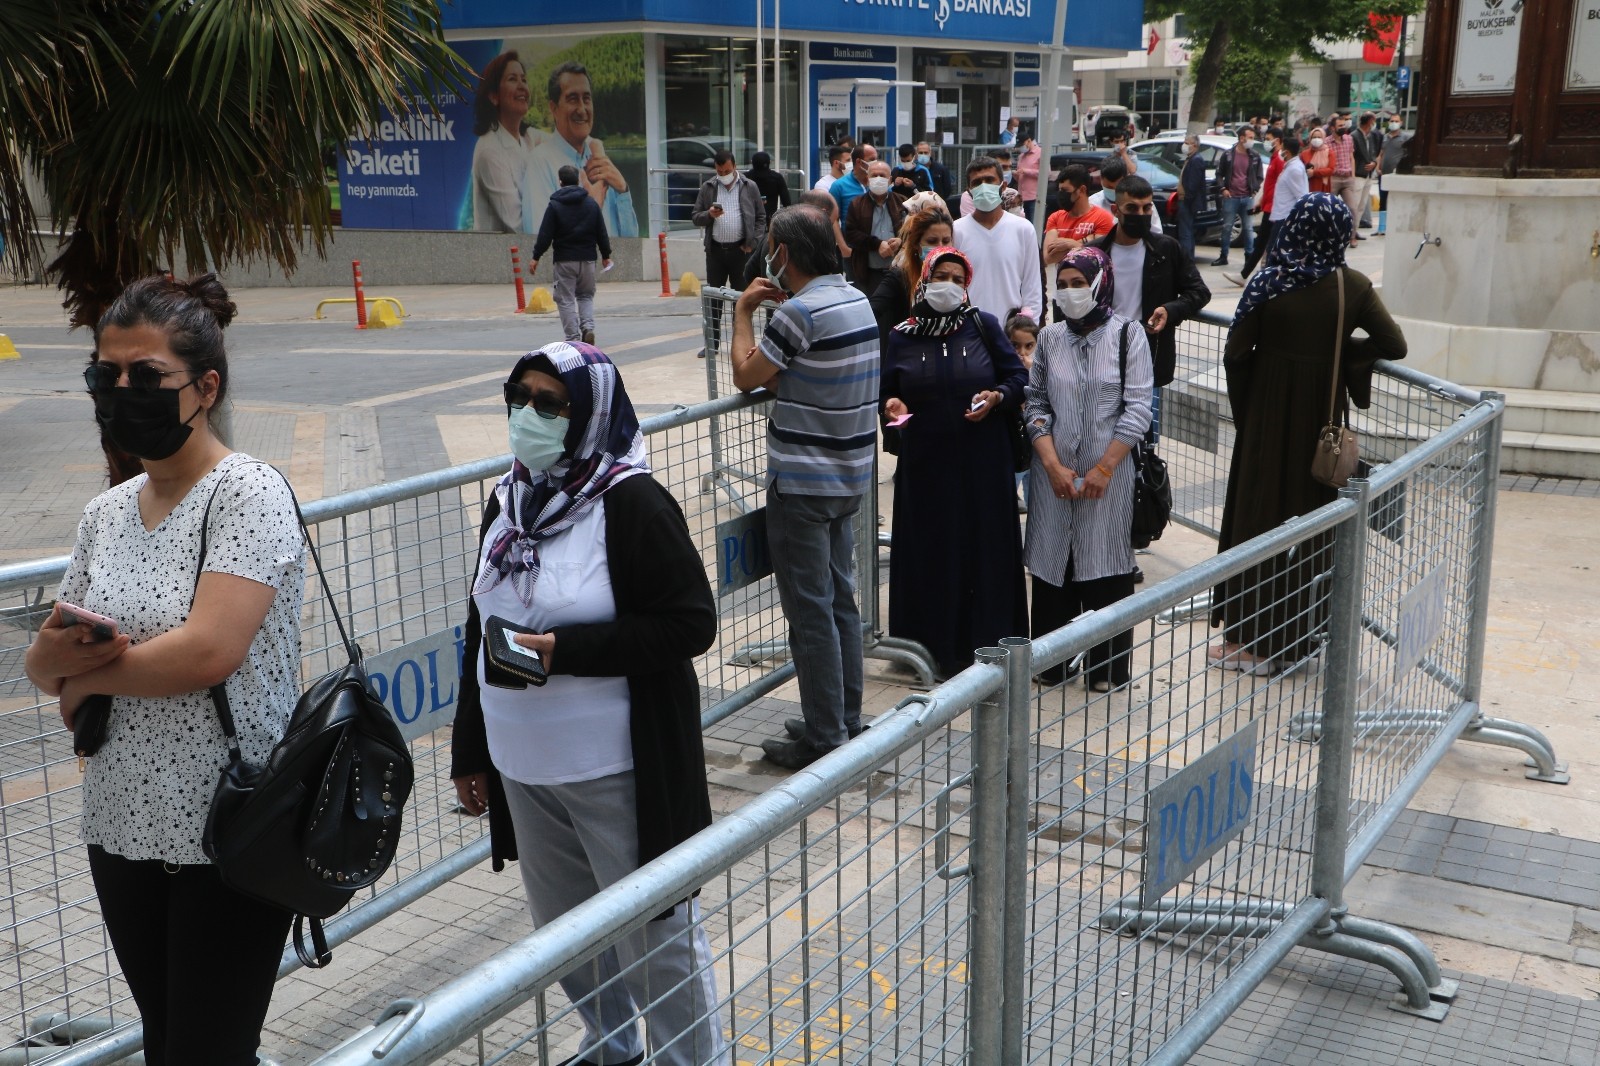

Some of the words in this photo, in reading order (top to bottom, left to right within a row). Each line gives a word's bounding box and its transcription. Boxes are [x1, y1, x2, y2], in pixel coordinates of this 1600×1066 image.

[954, 0, 1031, 18] BANKASI
[833, 46, 874, 59] Bankamatik
[345, 113, 456, 141] meklilik
[346, 148, 420, 176] Paketi
[347, 183, 366, 199] hep
[368, 184, 419, 199] yanınızda.
[1154, 741, 1255, 887] POLİS
